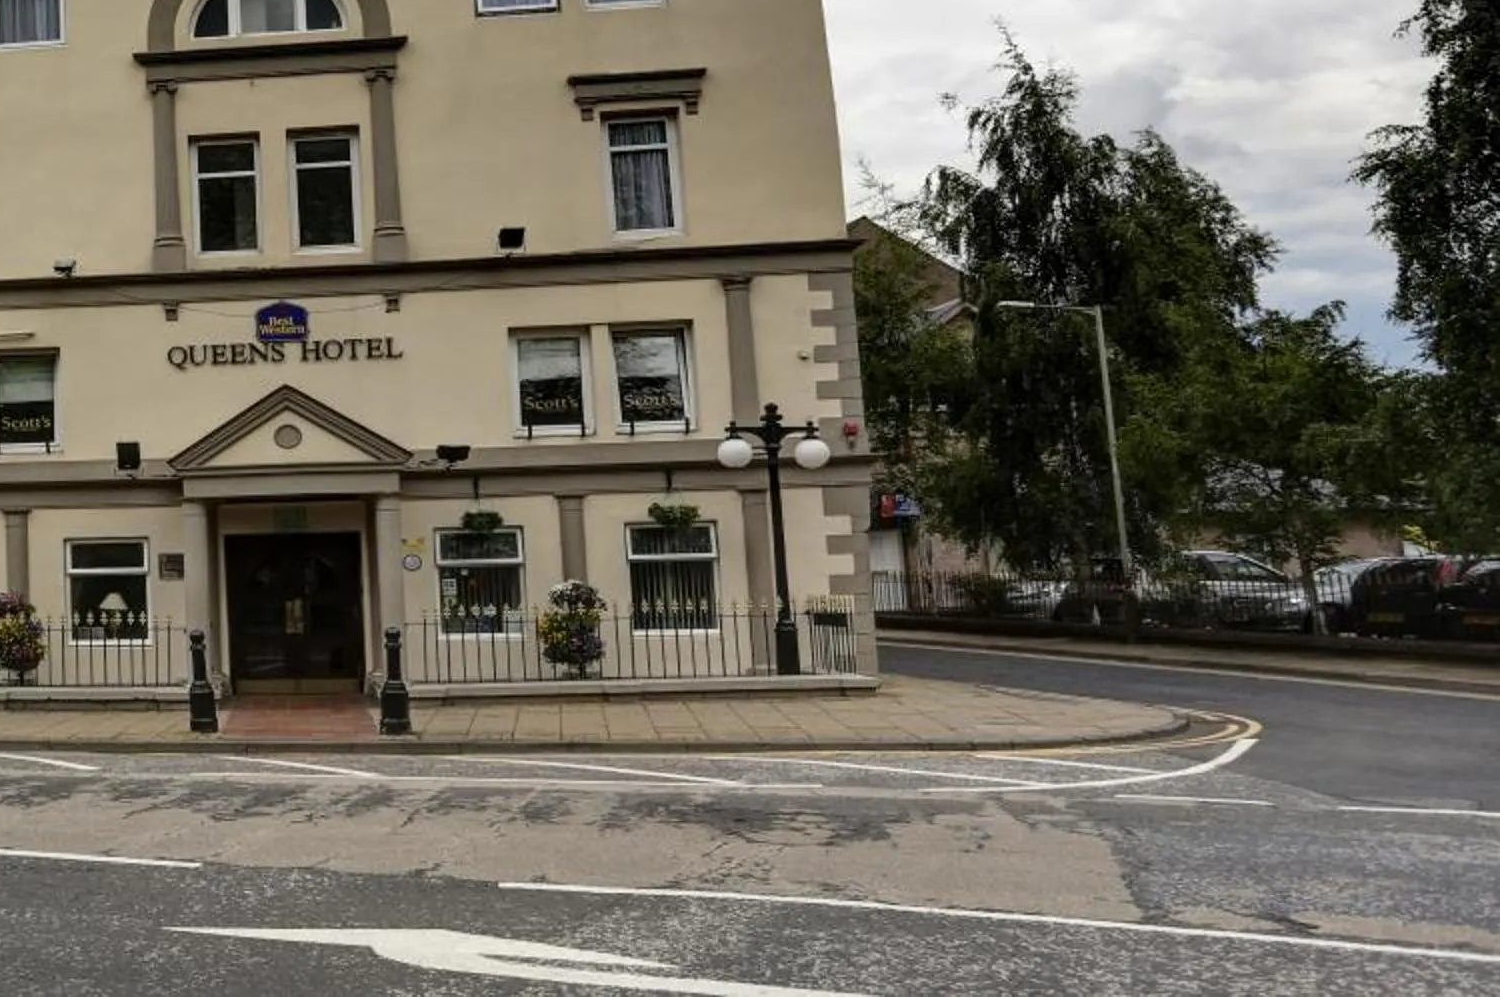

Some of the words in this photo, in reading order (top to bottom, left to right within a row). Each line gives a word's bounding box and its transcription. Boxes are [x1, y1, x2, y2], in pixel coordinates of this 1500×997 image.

[269, 316, 294, 326] Best
[167, 341, 287, 371] QUEENS
[301, 336, 403, 363] HOTEL
